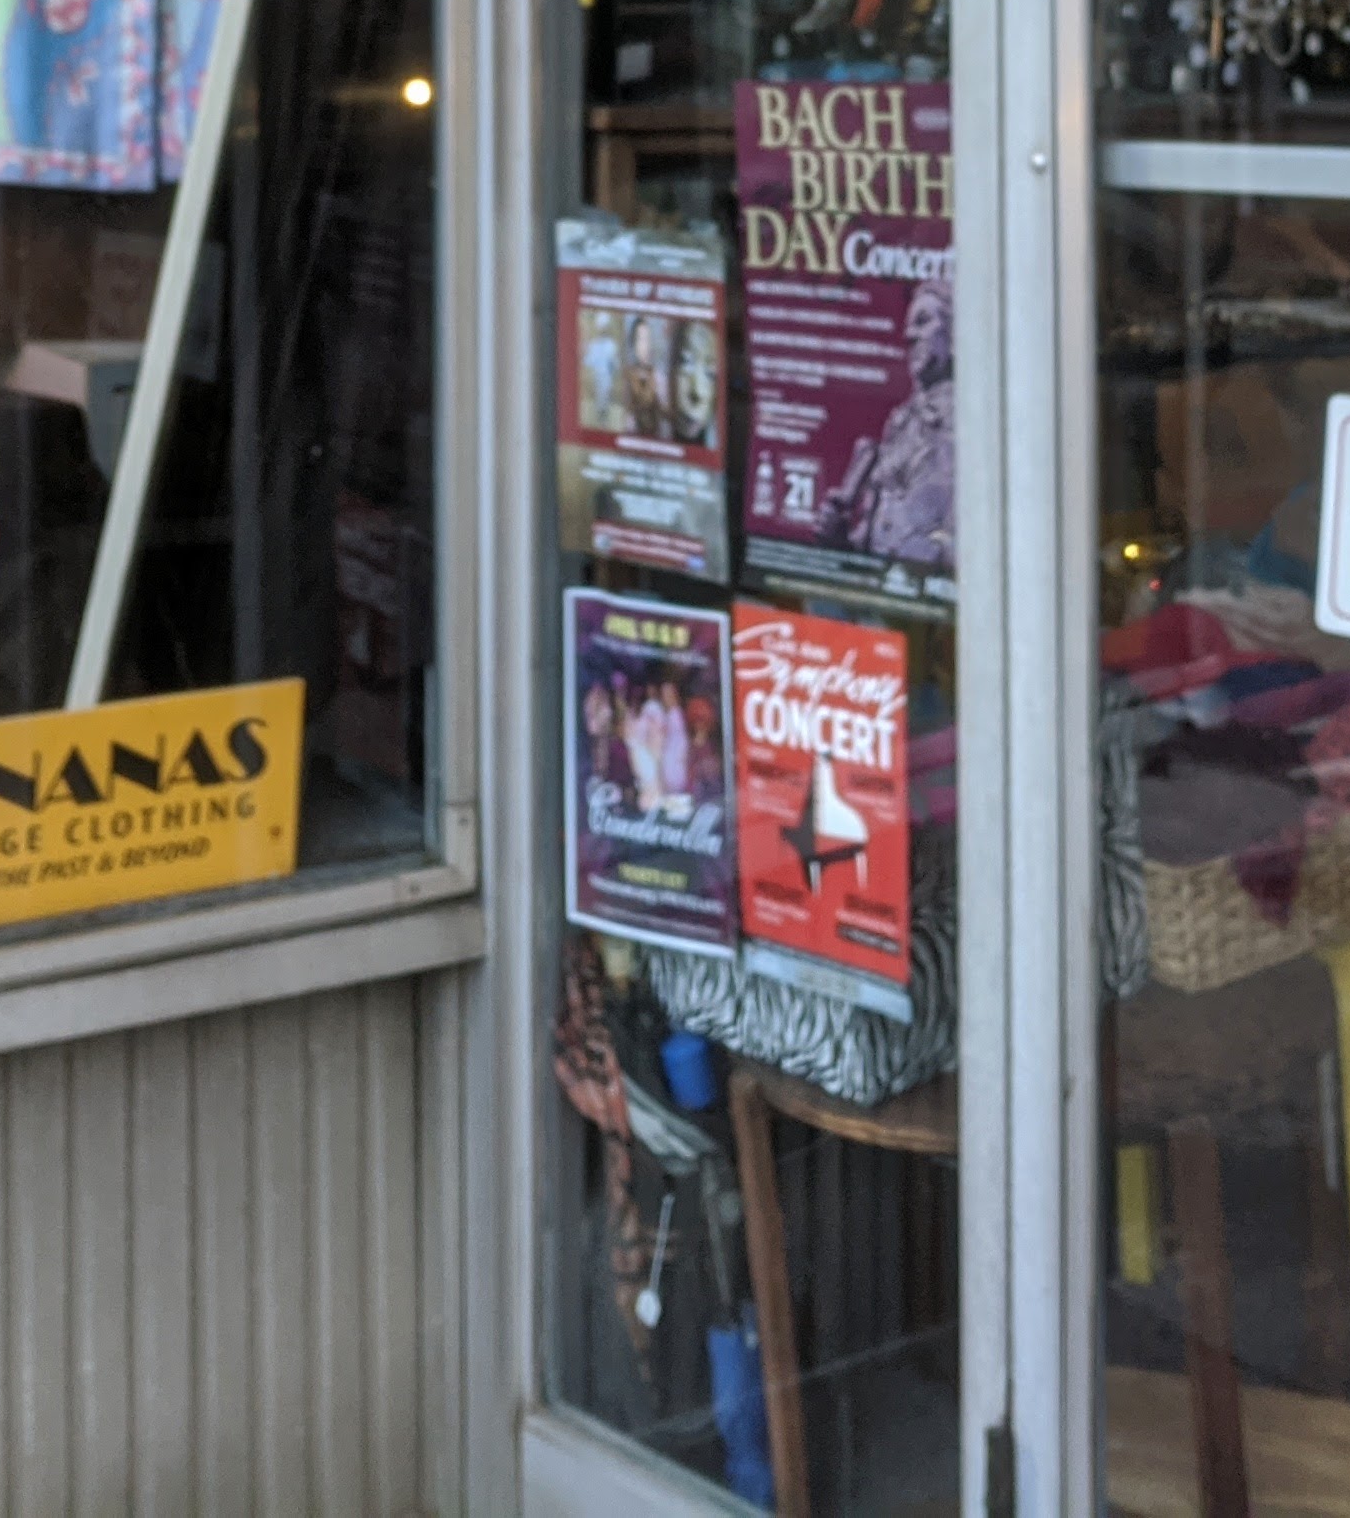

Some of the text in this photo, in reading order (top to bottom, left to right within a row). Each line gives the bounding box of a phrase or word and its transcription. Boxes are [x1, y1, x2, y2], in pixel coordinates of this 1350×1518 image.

[756, 85, 907, 151] BACH
[789, 149, 954, 219] BIRTH
[744, 205, 850, 274] DAY
[743, 689, 897, 772] CONCERT
[65, 791, 258, 846] CLOTHING
[38, 855, 93, 881] PAST
[98, 855, 114, 875] &
[120, 837, 211, 869] BEYOND
